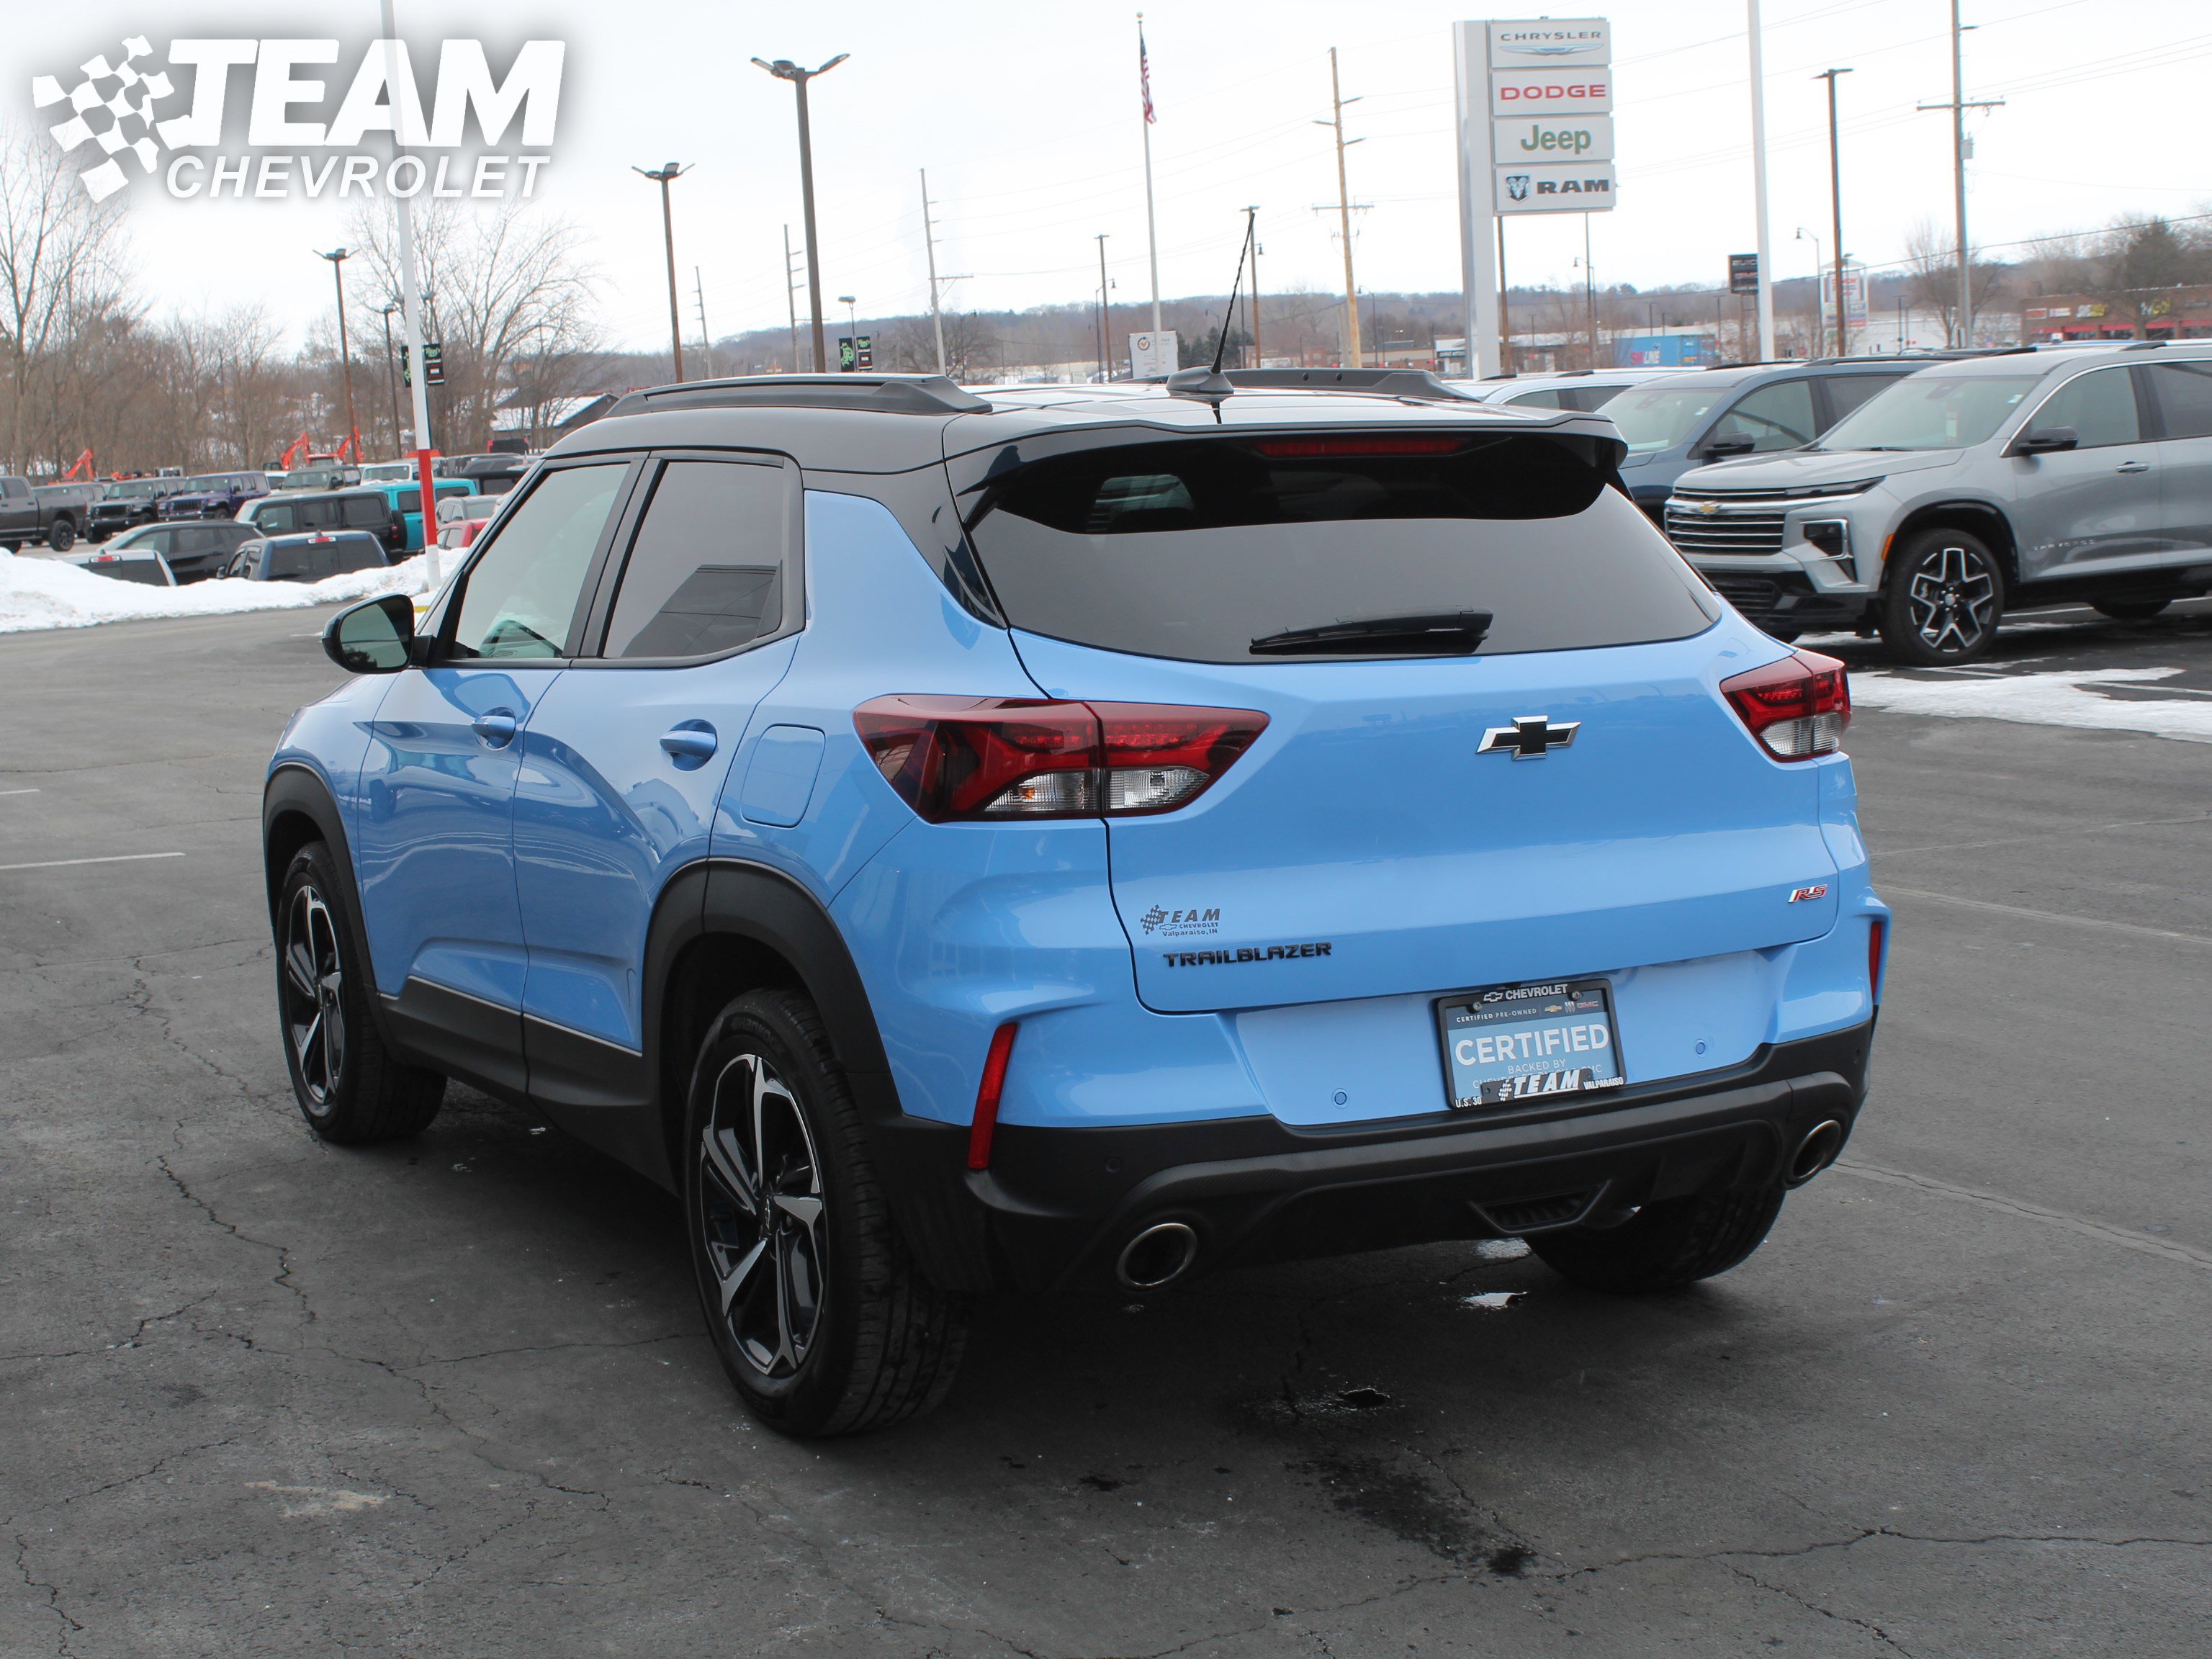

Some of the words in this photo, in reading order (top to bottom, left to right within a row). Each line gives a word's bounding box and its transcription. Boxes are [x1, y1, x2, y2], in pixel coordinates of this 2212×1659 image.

[1501, 31, 1601, 41] CHRYSLER
[1501, 84, 1606, 100] DODGE
[1521, 125, 1591, 154] Jeep
[1537, 179, 1609, 194] RAM
[1788, 884, 1827, 903] RS
[1159, 909, 1220, 923] TEAM
[1163, 942, 1332, 968] TRAILBLAZER
[1505, 984, 1568, 1000] CHEVROLET
[1456, 1013, 1493, 1023] CERTIFIED
[1496, 1008, 1537, 1018] PRE-OWNED
[1455, 1023, 1609, 1066] CERTIFIED
[1508, 1061, 1549, 1074] BACKED
[1553, 1058, 1565, 1069] BY
[1514, 1069, 1580, 1095] TEAM
[1583, 1076, 1623, 1089] VALPARAISO
[1455, 1098, 1471, 1108] U.S.
[1473, 1096, 1482, 1105] 30
